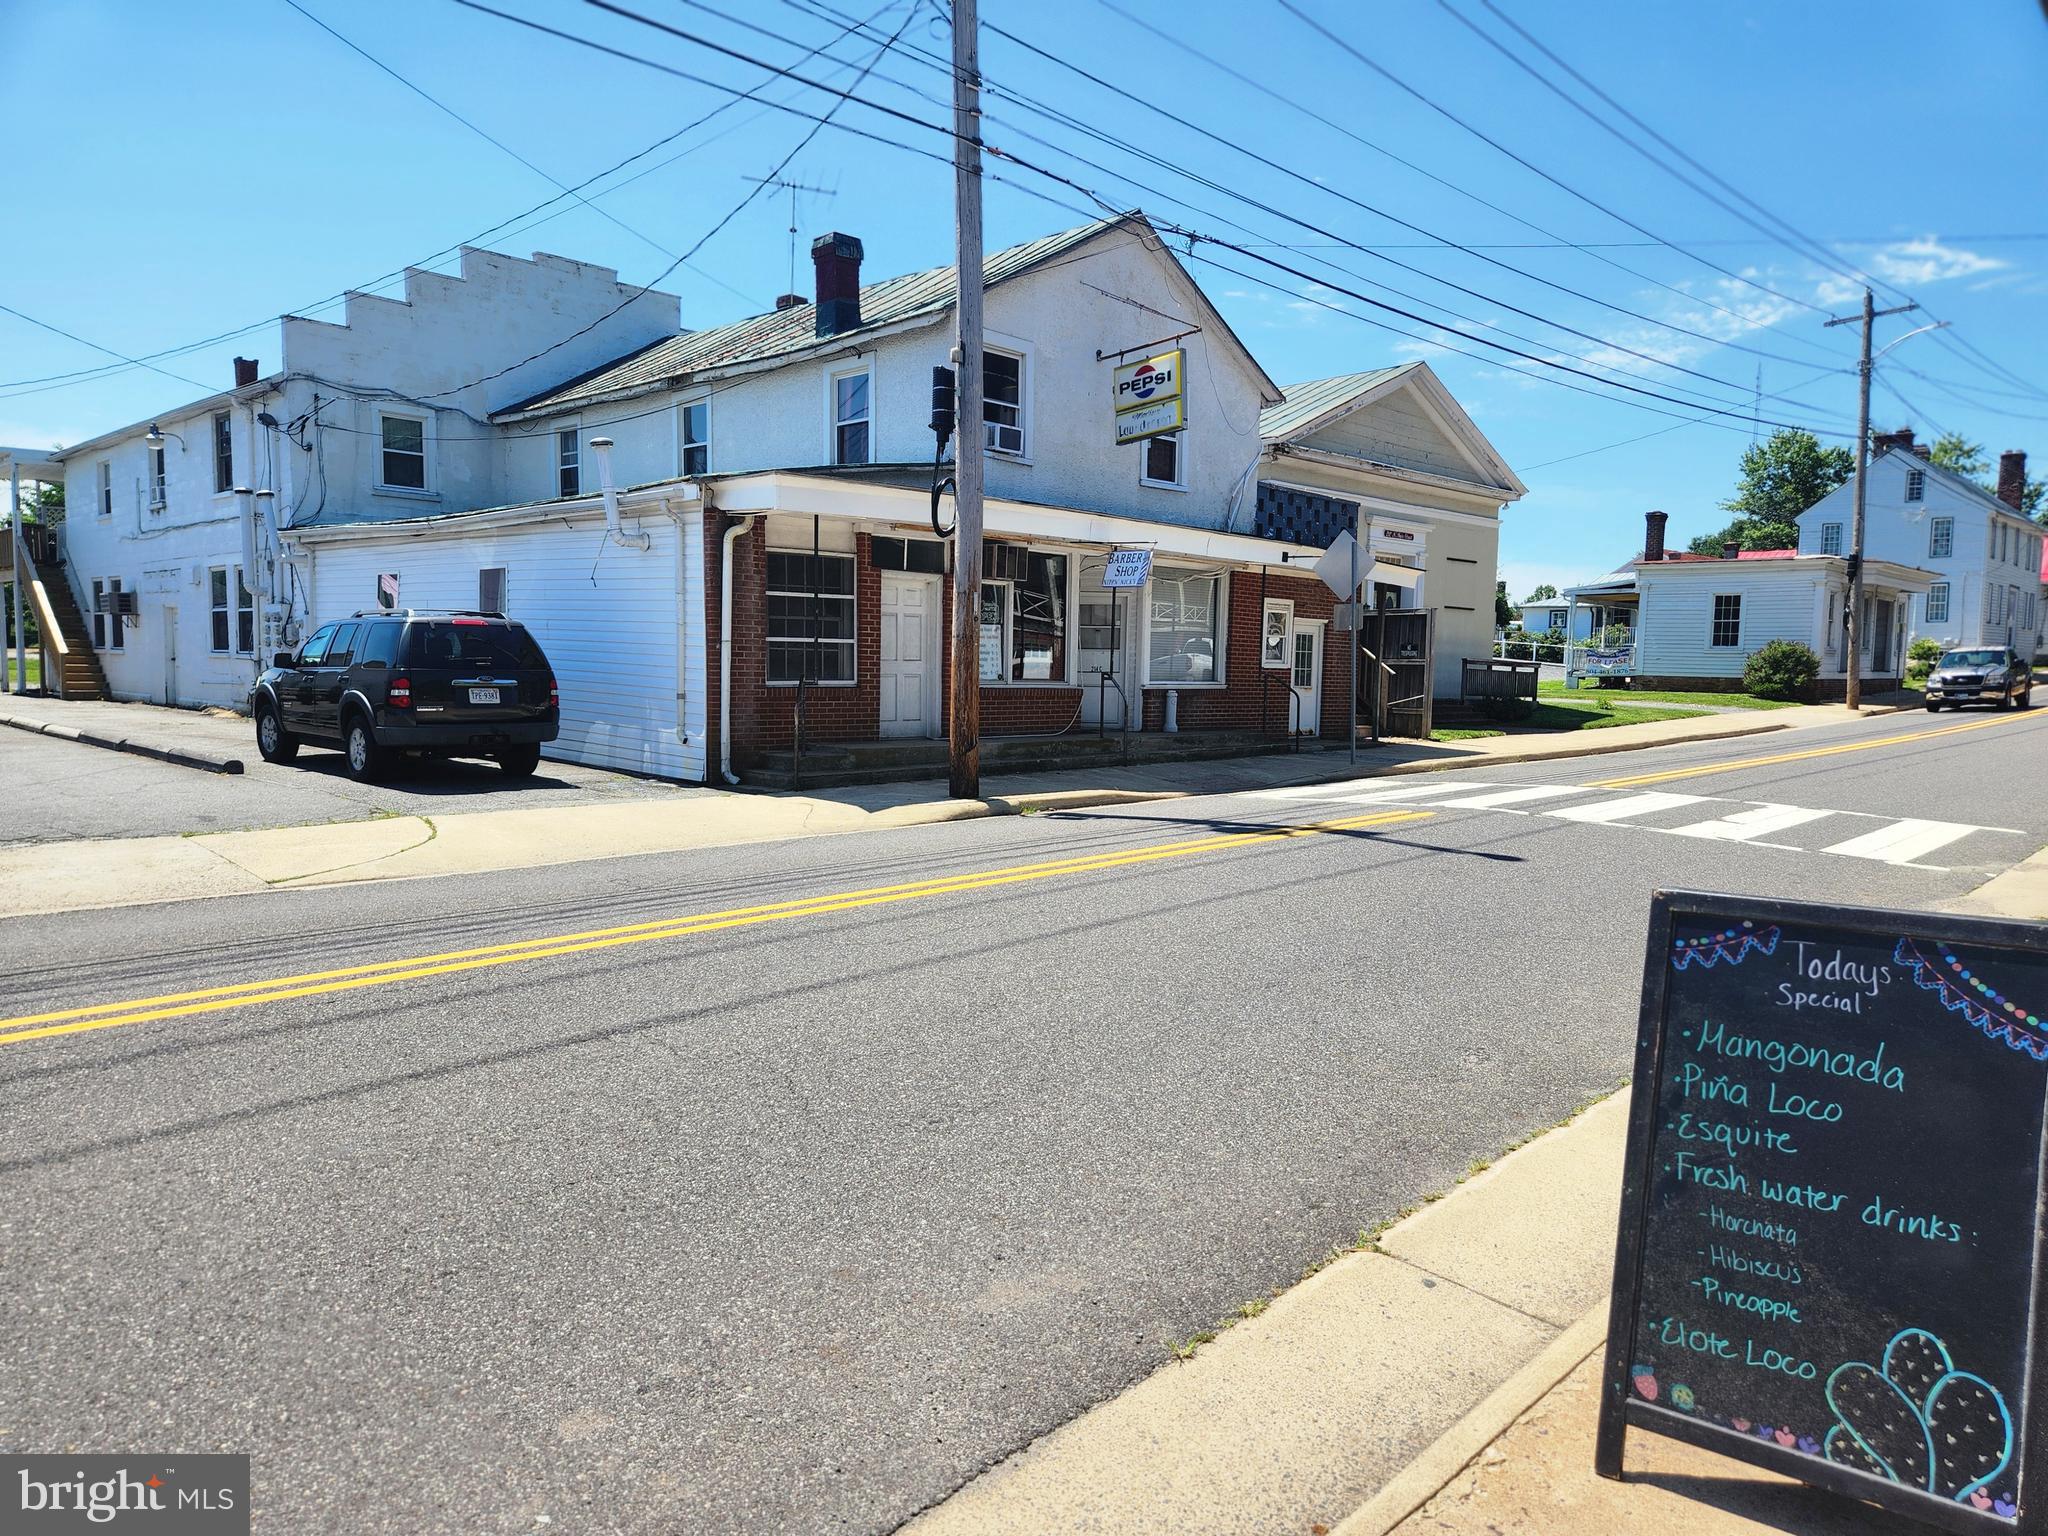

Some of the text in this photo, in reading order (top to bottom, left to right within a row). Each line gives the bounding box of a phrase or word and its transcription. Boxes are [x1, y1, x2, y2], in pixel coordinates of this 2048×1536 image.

[1119, 370, 1172, 395] PEPSI
[1108, 552, 1143, 564] BARBER
[1115, 565, 1139, 577] SHOP
[1588, 657, 1628, 665] FOR LEASE
[1783, 940, 1892, 996] Todays
[1776, 983, 1861, 1014] Special
[1697, 1020, 1905, 1093] Mangonada
[1684, 1063, 1748, 1107] Piña
[1678, 1114, 1798, 1157] Esquite
[1675, 1152, 1748, 1194] Fresh
[1762, 1180, 1848, 1211] water
[1661, 1317, 1738, 1358] Elote
